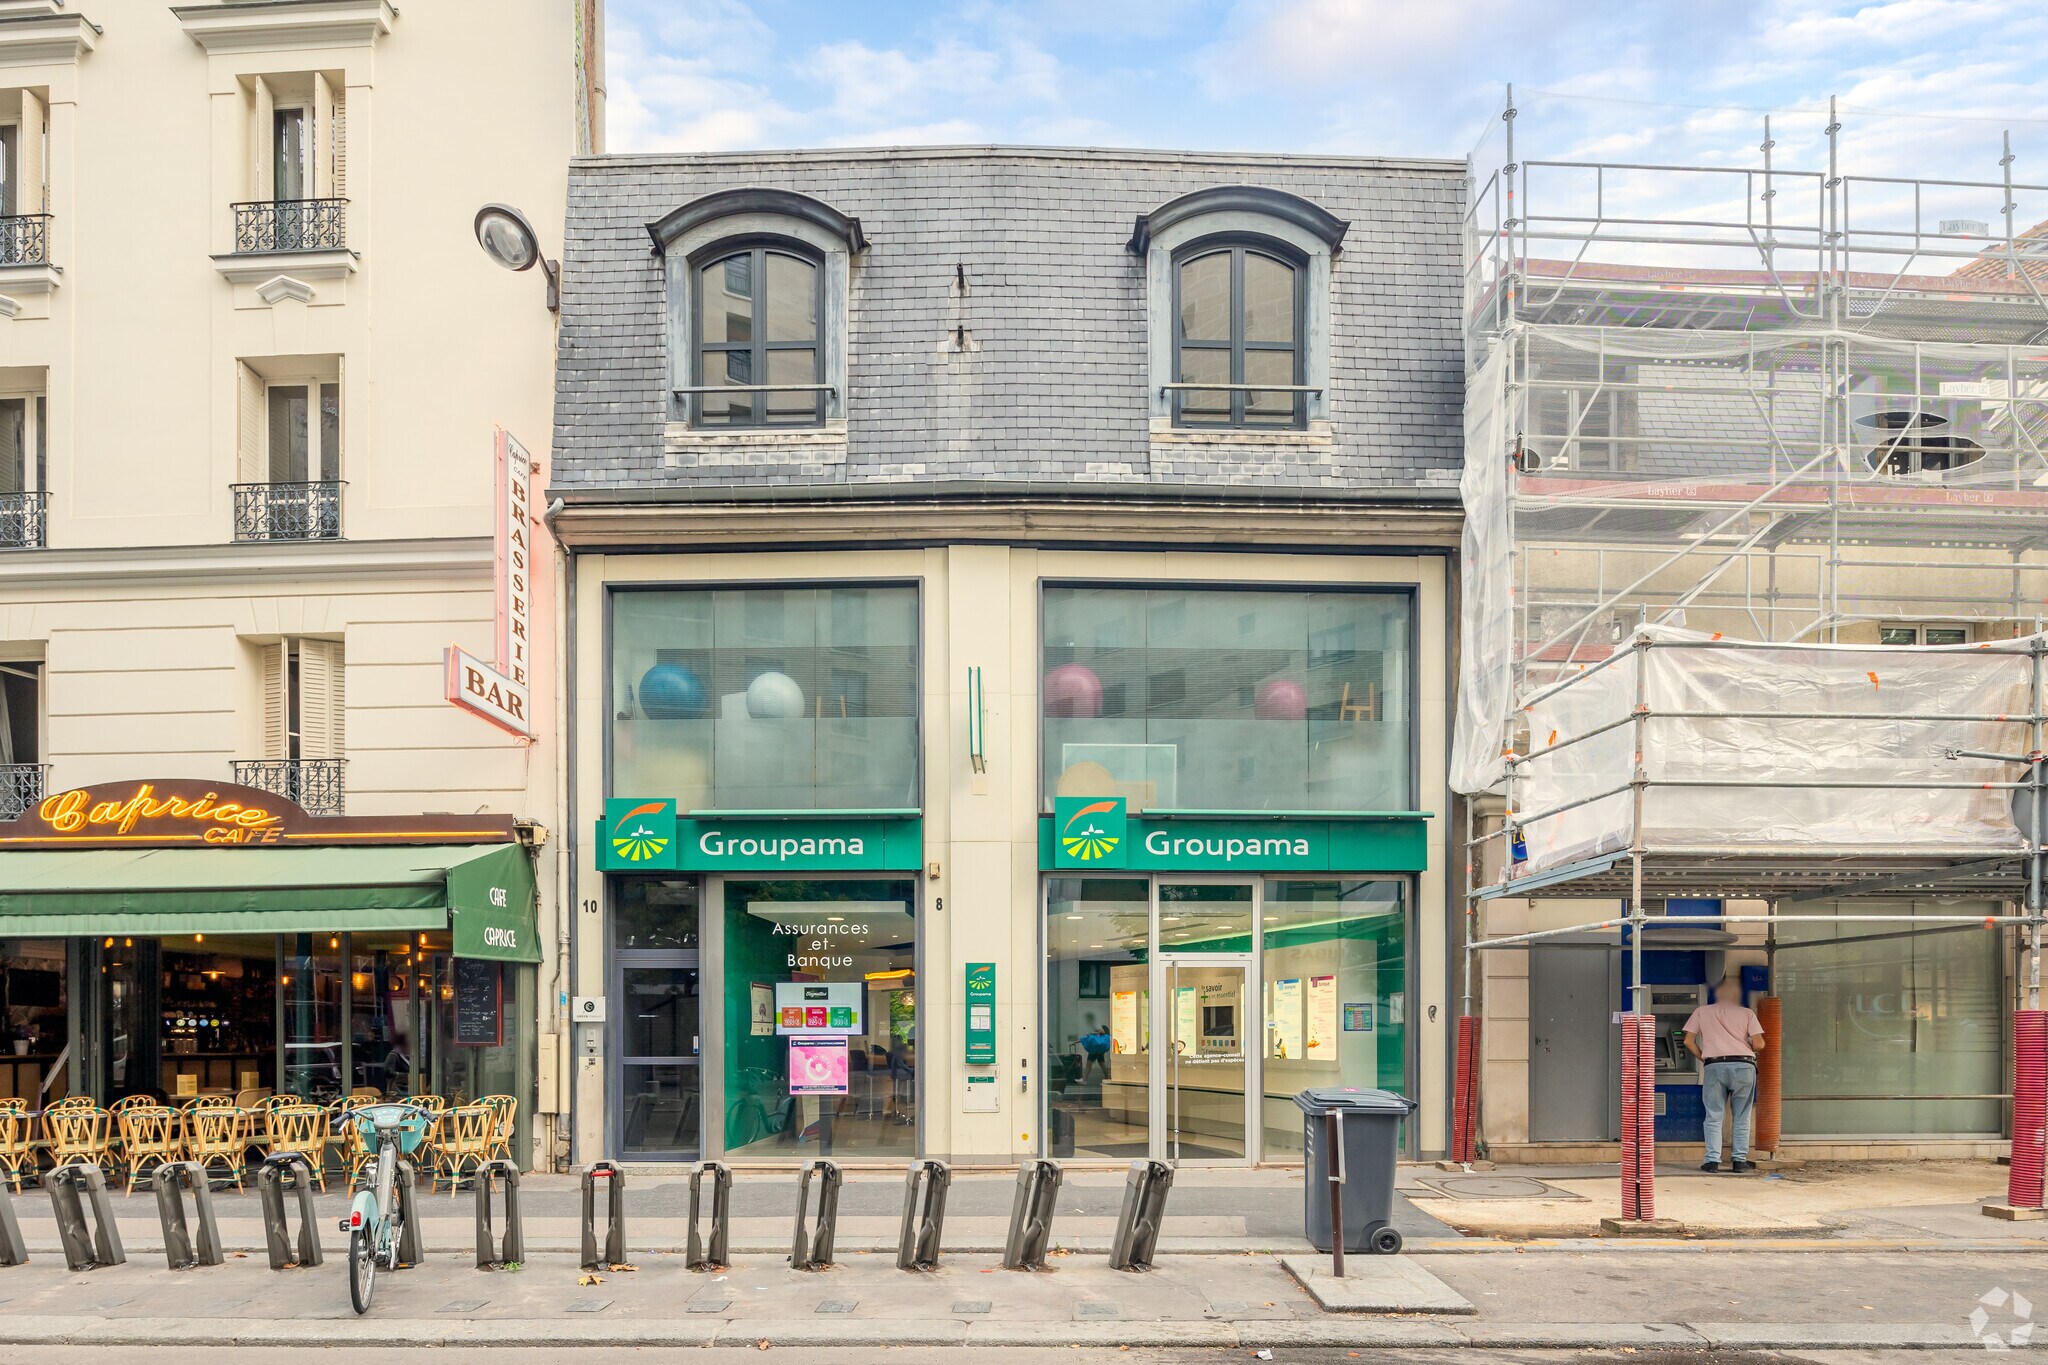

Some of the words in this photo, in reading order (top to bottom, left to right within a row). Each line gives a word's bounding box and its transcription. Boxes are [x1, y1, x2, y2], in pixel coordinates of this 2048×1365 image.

[1942, 220, 1976, 232] Layher
[1942, 383, 1974, 394] Layher
[513, 466, 527, 481] CAFE
[1647, 485, 1683, 497] Layher
[1946, 491, 1980, 504] Layher
[511, 478, 527, 686] BRASSERIE
[465, 665, 525, 721] BAR
[39, 784, 284, 835] Caprice
[203, 826, 285, 843] CAFE
[699, 831, 864, 861] Groupama
[1145, 830, 1309, 862] Groupama
[489, 887, 507, 908] CAFE
[936, 897, 943, 911] 8
[582, 899, 598, 913] 10
[772, 922, 869, 935] Assurances
[484, 927, 517, 948] CAPRICE
[787, 954, 853, 969] Banque
[1205, 983, 1222, 992] savoir
[1856, 992, 1916, 1014] LCL
